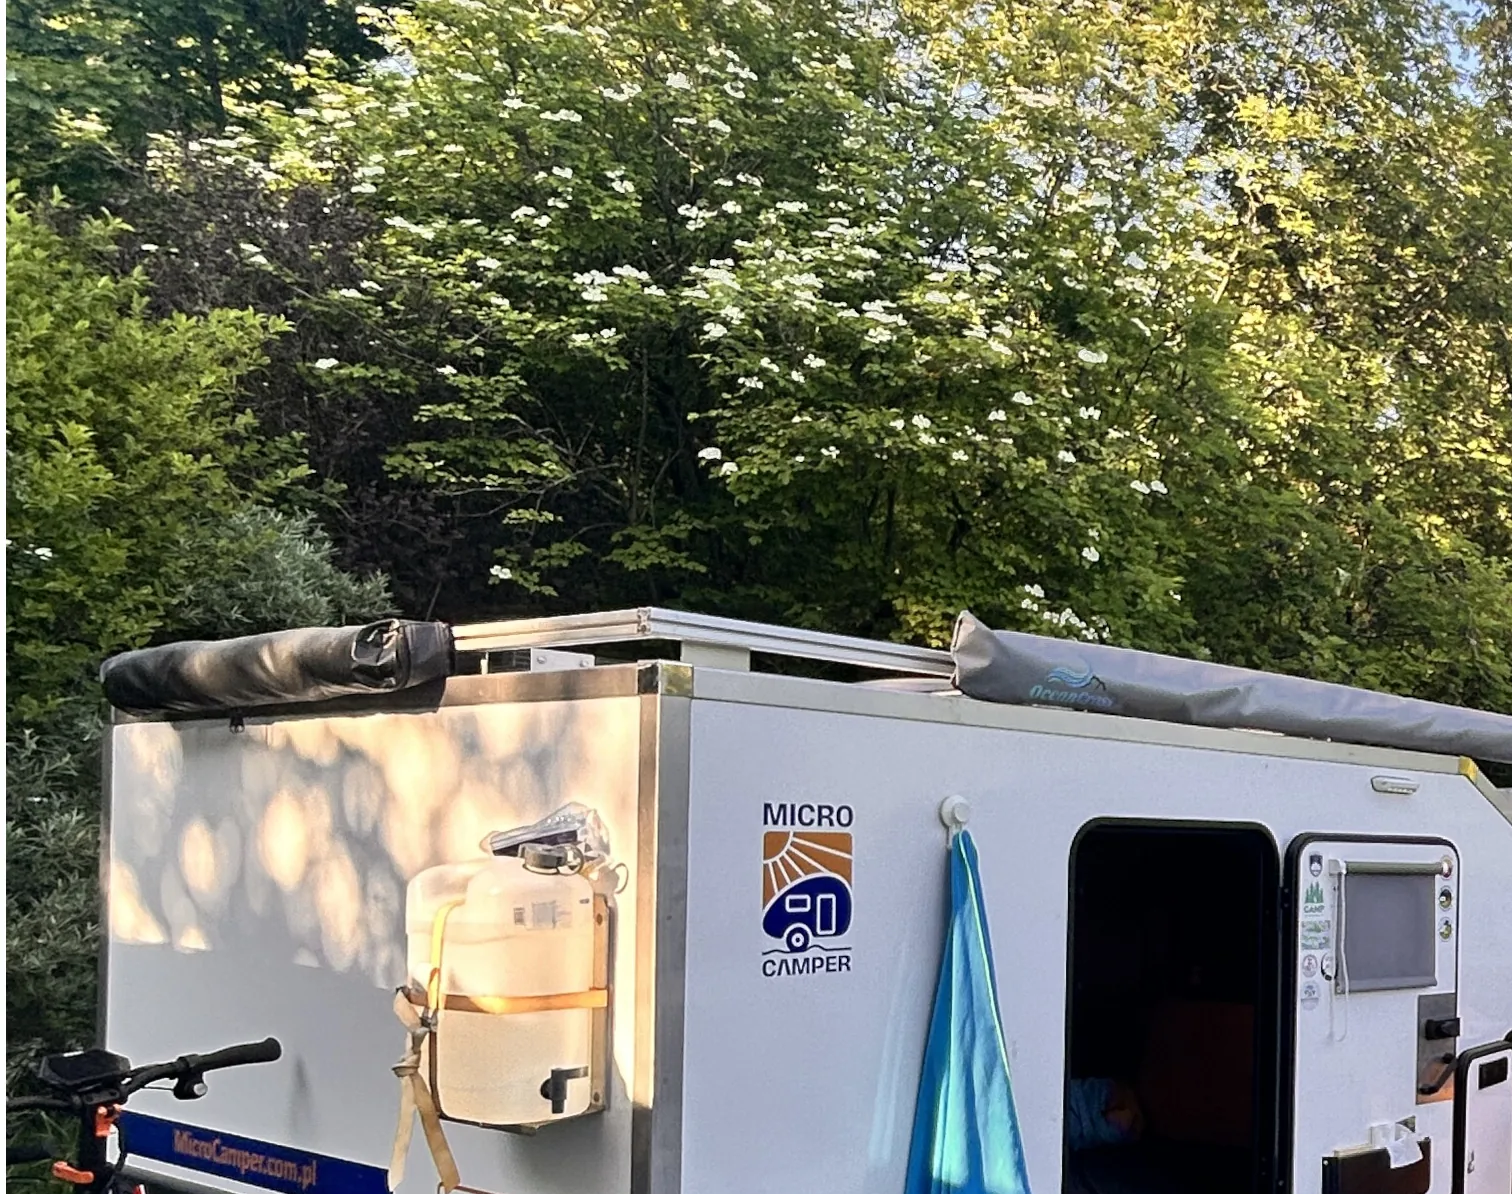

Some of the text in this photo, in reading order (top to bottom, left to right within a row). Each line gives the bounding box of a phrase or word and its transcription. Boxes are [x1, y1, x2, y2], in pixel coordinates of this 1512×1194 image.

[763, 803, 854, 828] MICRO
[762, 955, 851, 978] CAMPER
[173, 1129, 317, 1190] MicroCamper.com.pl
